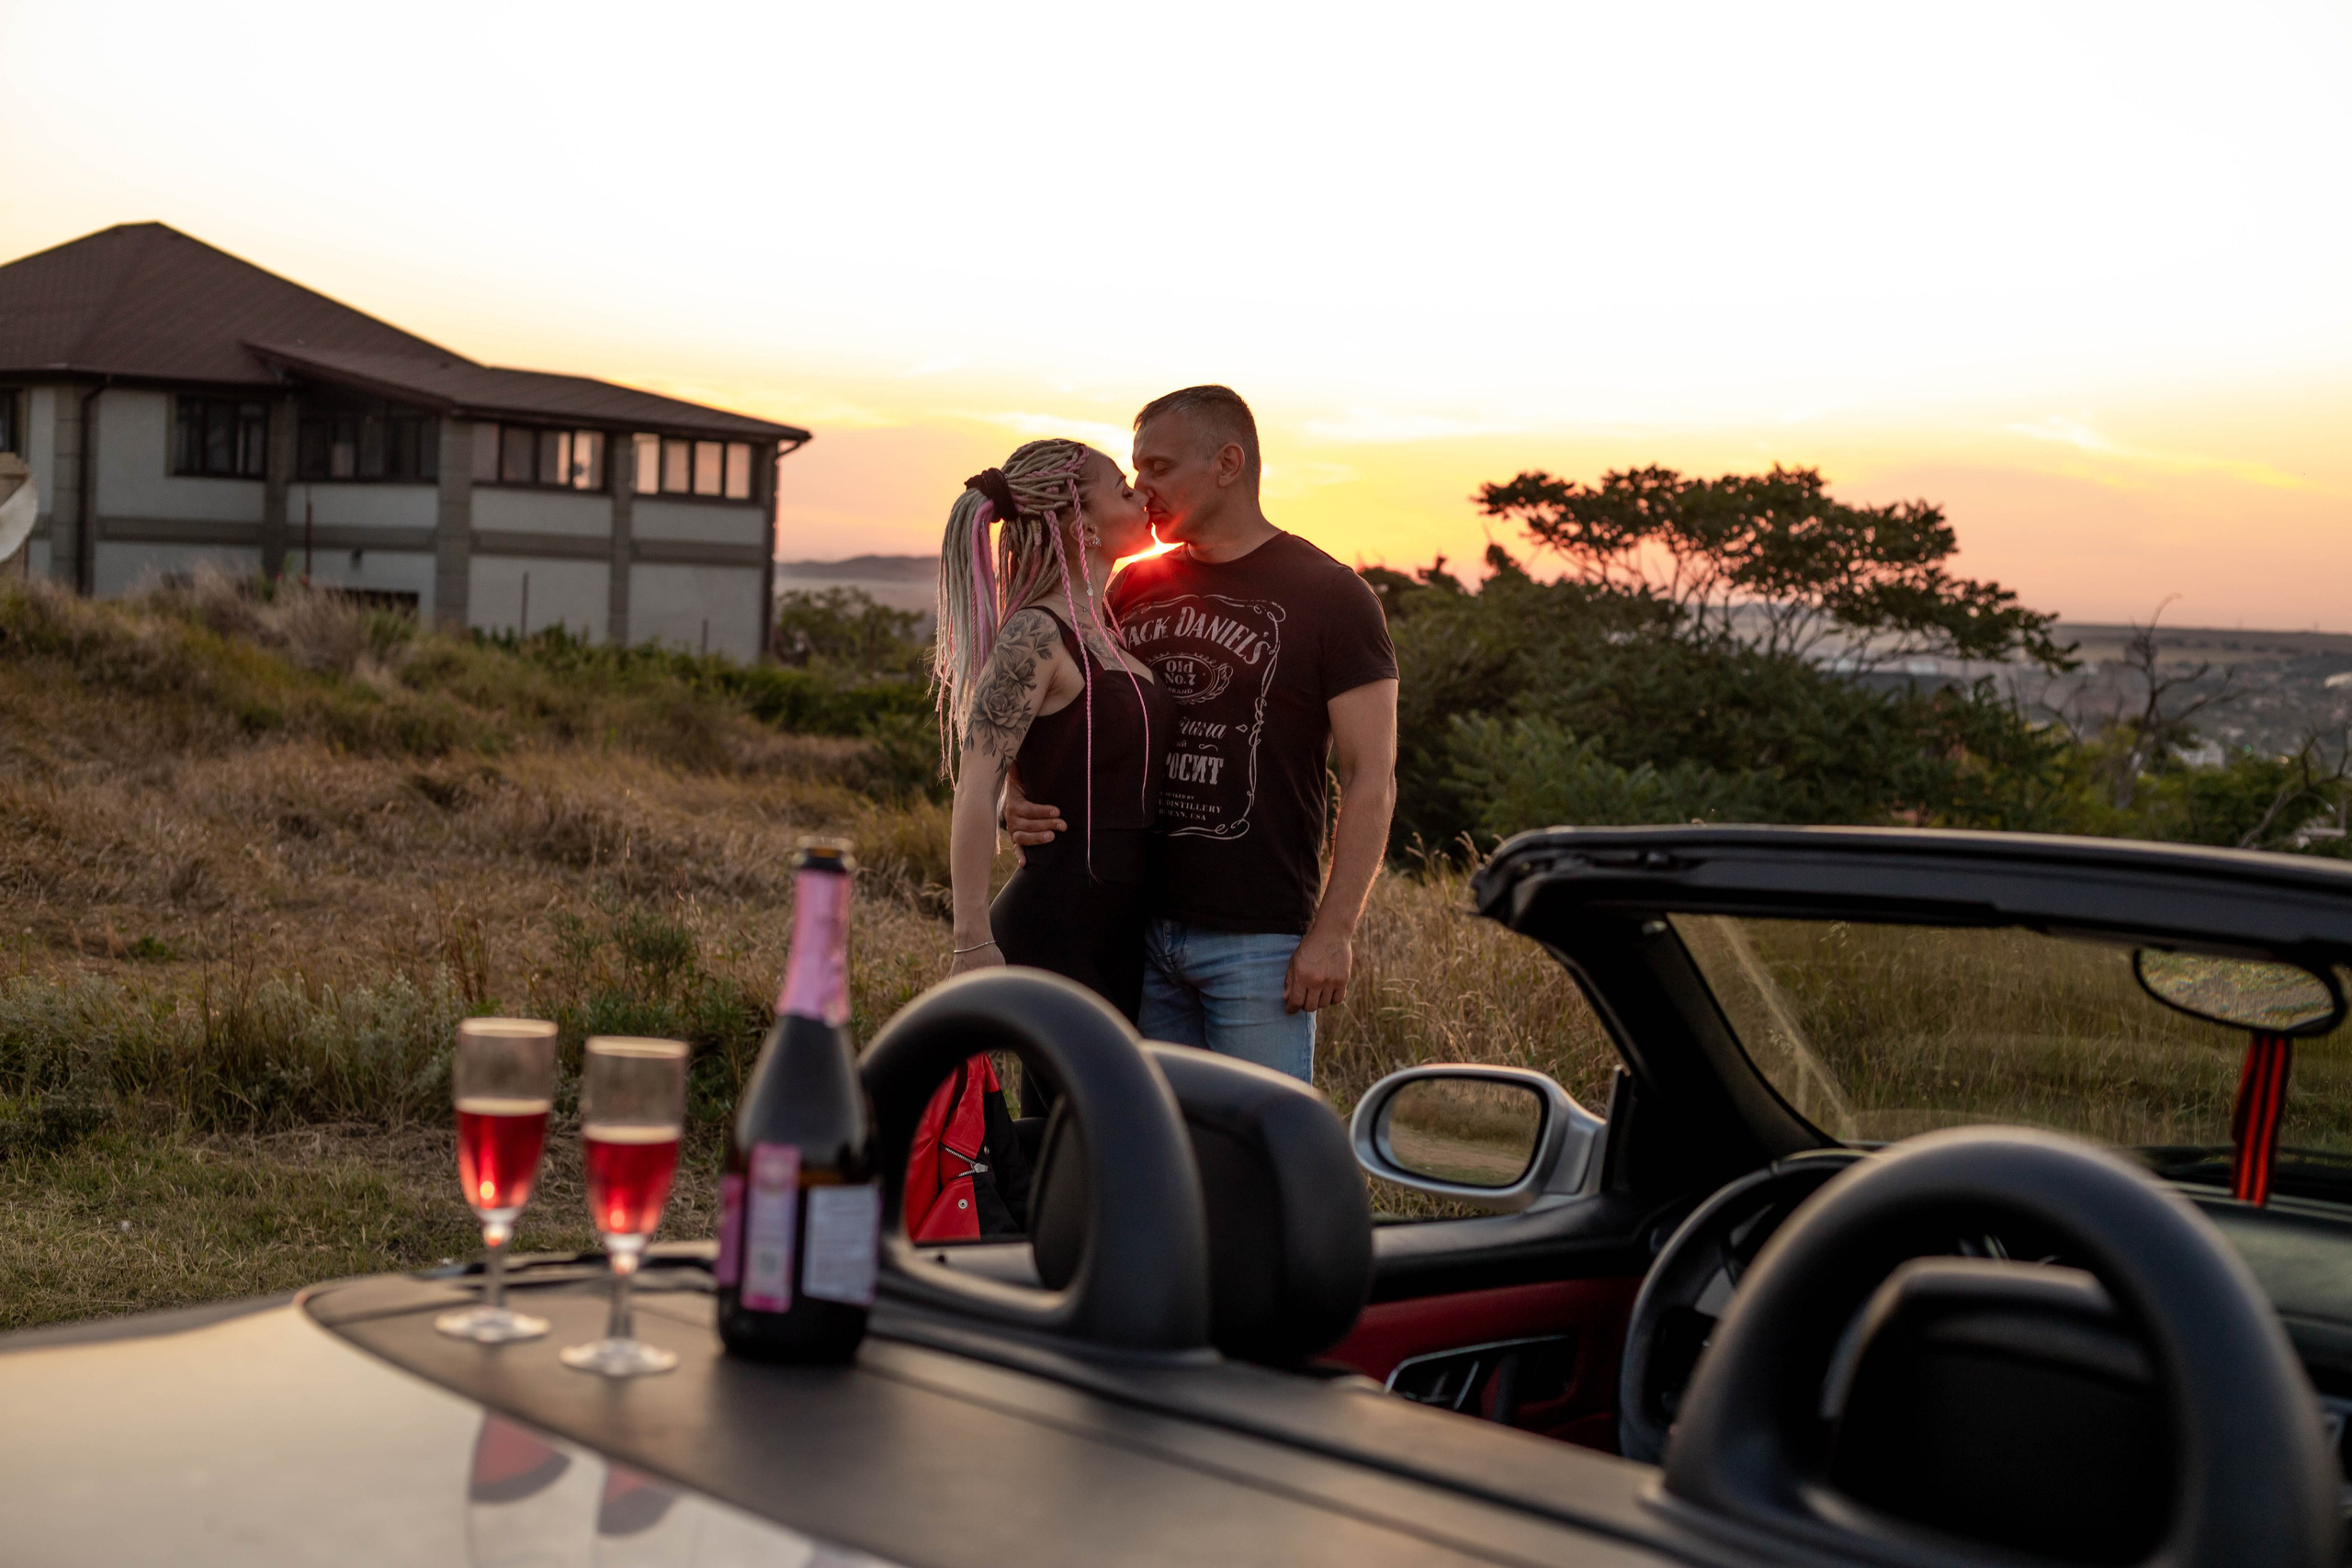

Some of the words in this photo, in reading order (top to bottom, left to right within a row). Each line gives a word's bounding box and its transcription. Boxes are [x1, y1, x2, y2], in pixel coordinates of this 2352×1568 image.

[1174, 606, 1272, 665] DANIEL'S
[1165, 660, 1193, 673] Old
[1167, 799, 1221, 813] DISTILLERY
